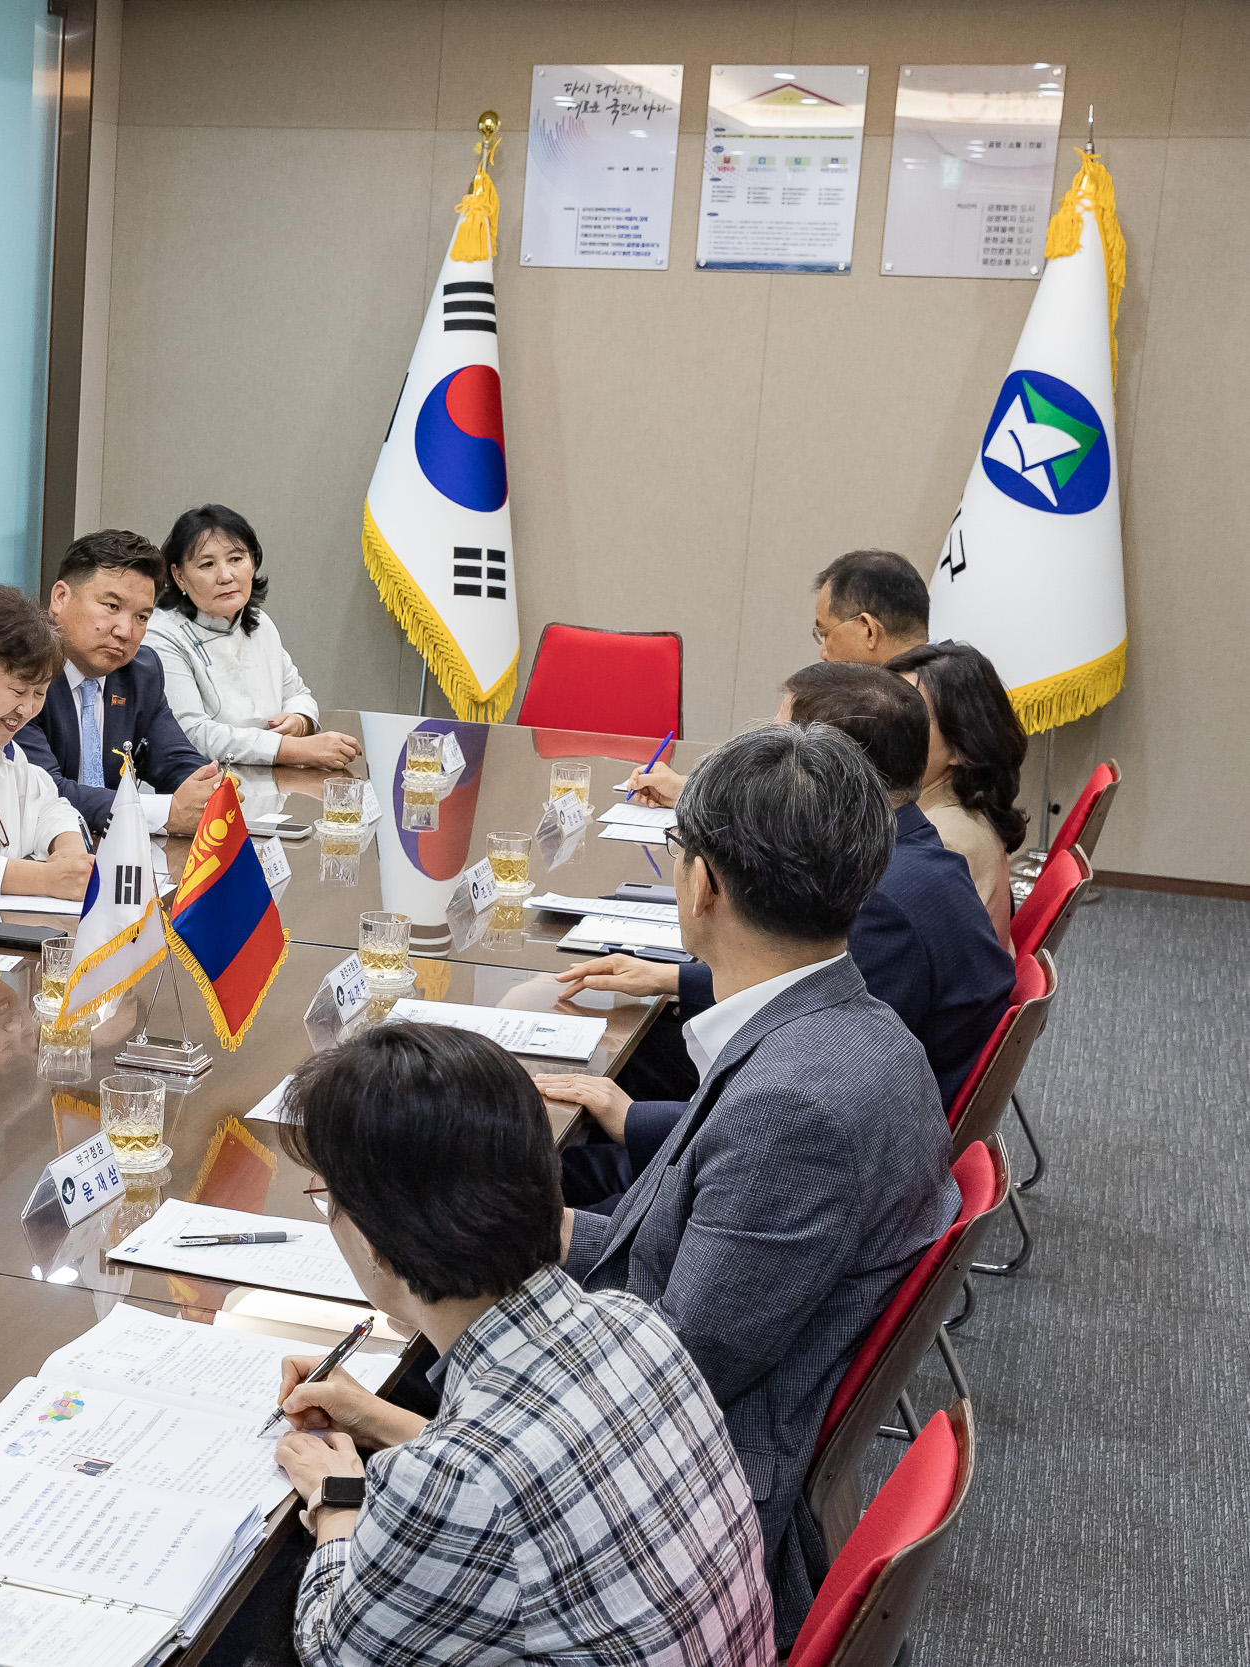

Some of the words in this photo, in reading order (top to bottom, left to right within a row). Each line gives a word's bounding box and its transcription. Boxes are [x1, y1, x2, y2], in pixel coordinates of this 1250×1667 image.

[563, 80, 591, 96] 다시
[606, 98, 639, 126] 국민의
[642, 99, 673, 120] 나라
[75, 1141, 104, 1167] 부구청장
[81, 1165, 119, 1203] 윤재삼
